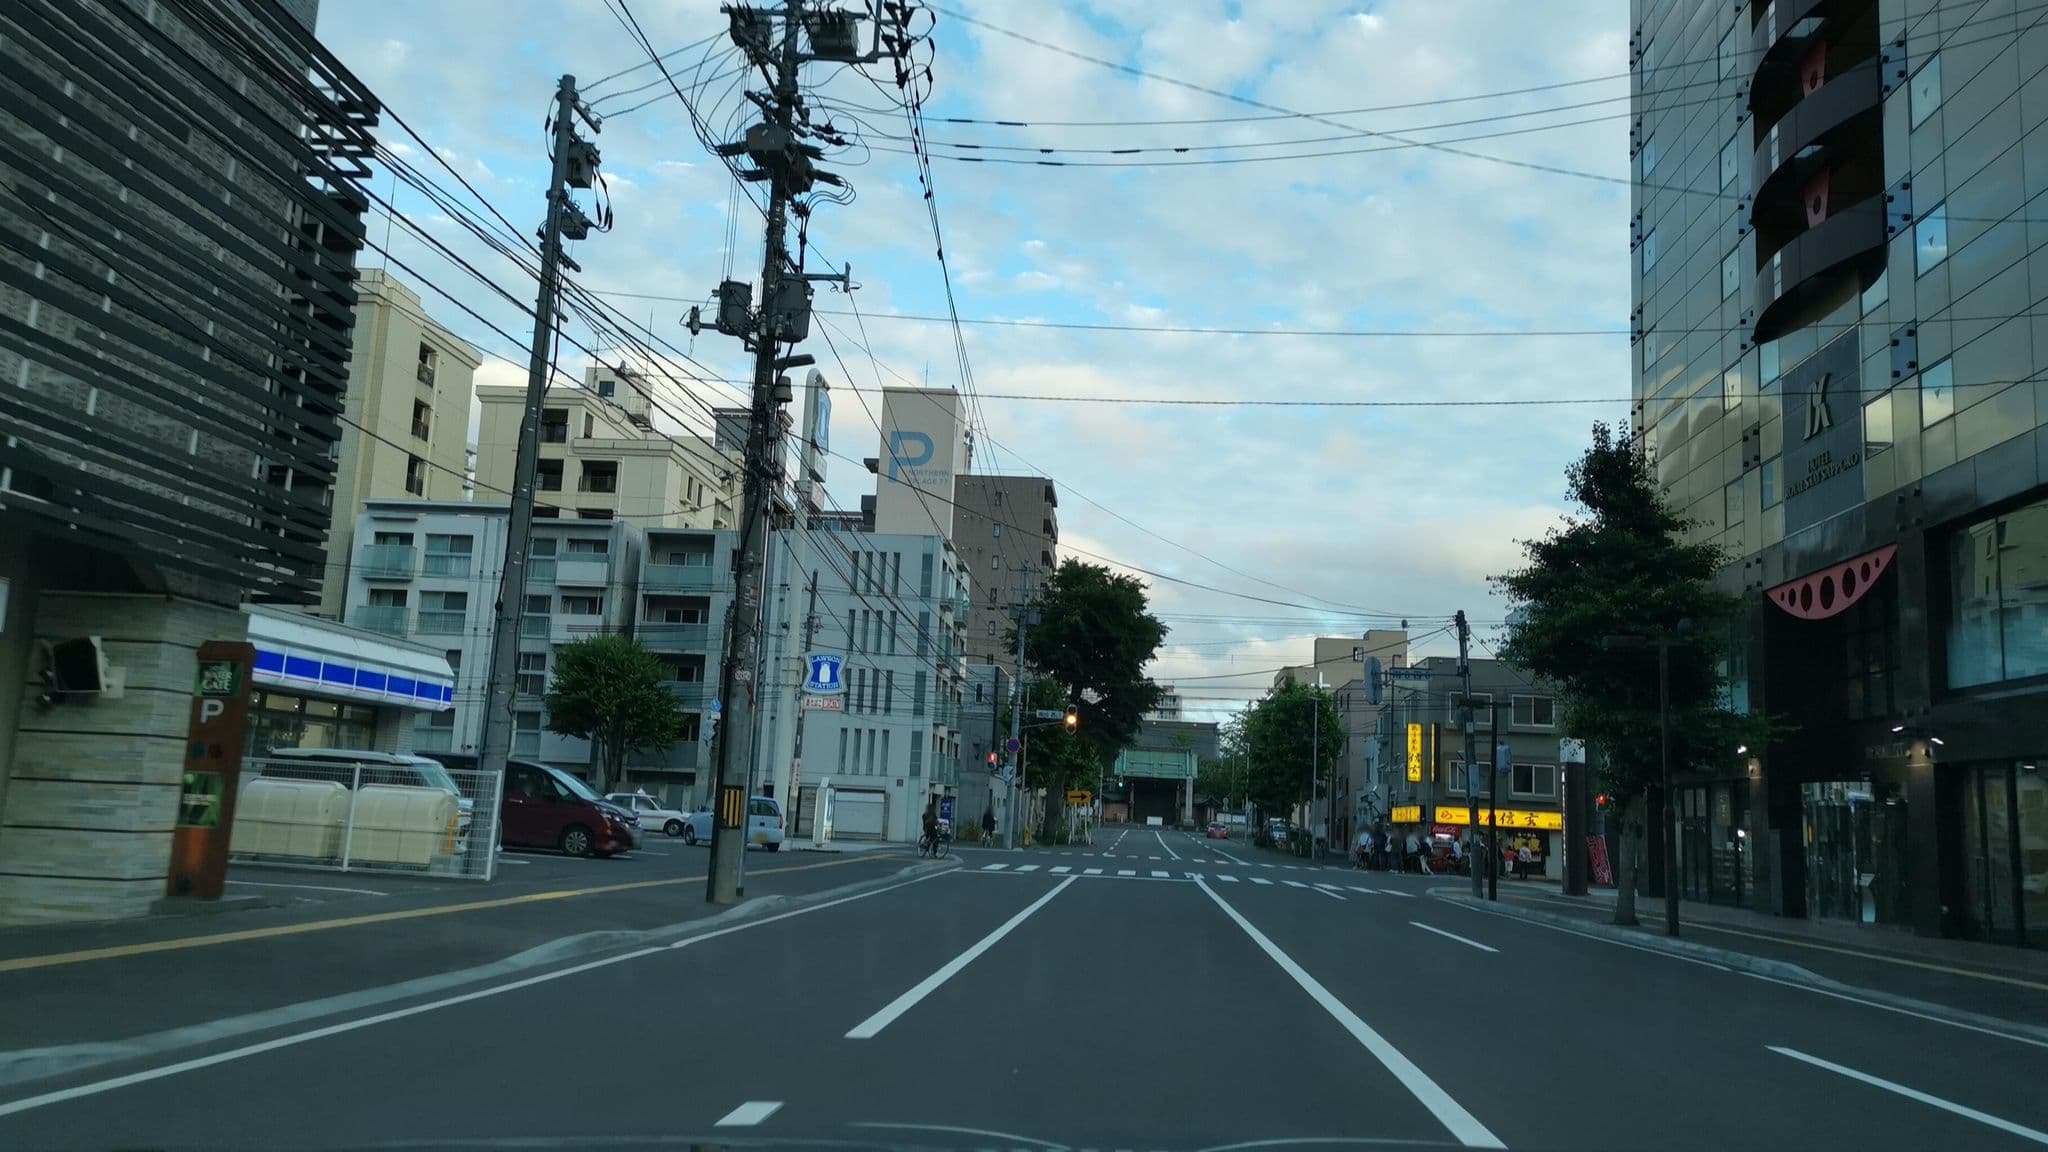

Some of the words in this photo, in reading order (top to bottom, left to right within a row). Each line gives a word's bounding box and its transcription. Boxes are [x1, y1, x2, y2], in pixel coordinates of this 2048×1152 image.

[811, 655, 842, 664] LAWSON
[808, 681, 839, 689] STATION
[200, 699, 224, 724] P
[1440, 810, 1540, 827] らー信玄
